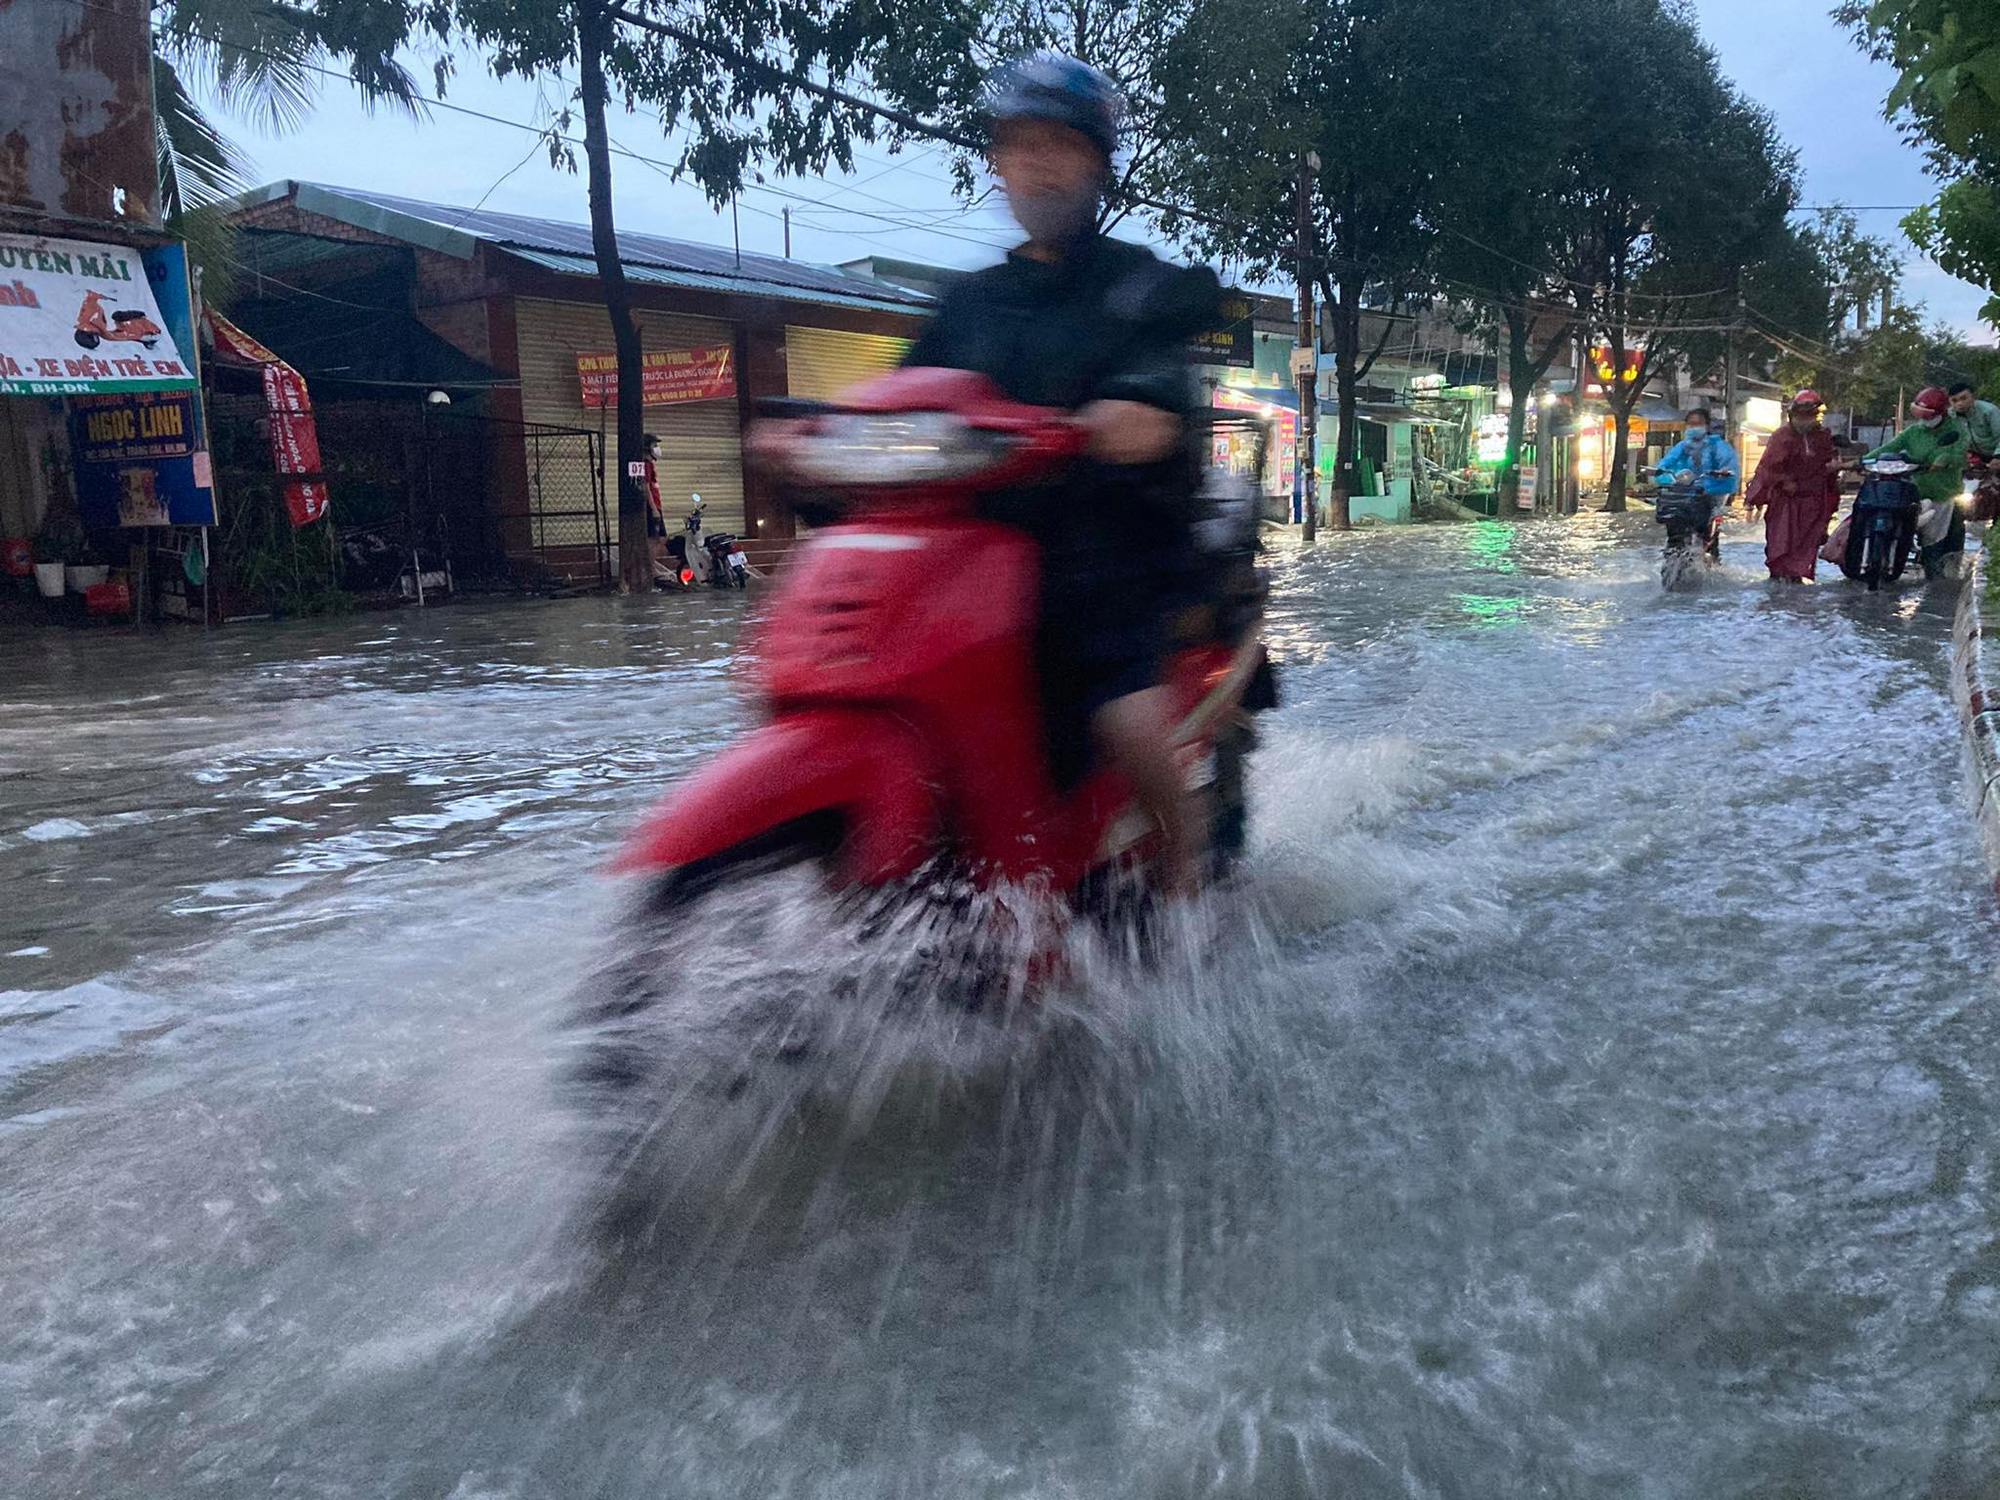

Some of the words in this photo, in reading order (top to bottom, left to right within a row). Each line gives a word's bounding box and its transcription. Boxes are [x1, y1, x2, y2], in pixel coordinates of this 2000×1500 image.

[77, 252, 132, 281] MÃI
[33, 358, 63, 377] XE
[112, 354, 153, 377] TRẺ
[153, 359, 185, 376] EM
[140, 405, 183, 437] LINH
